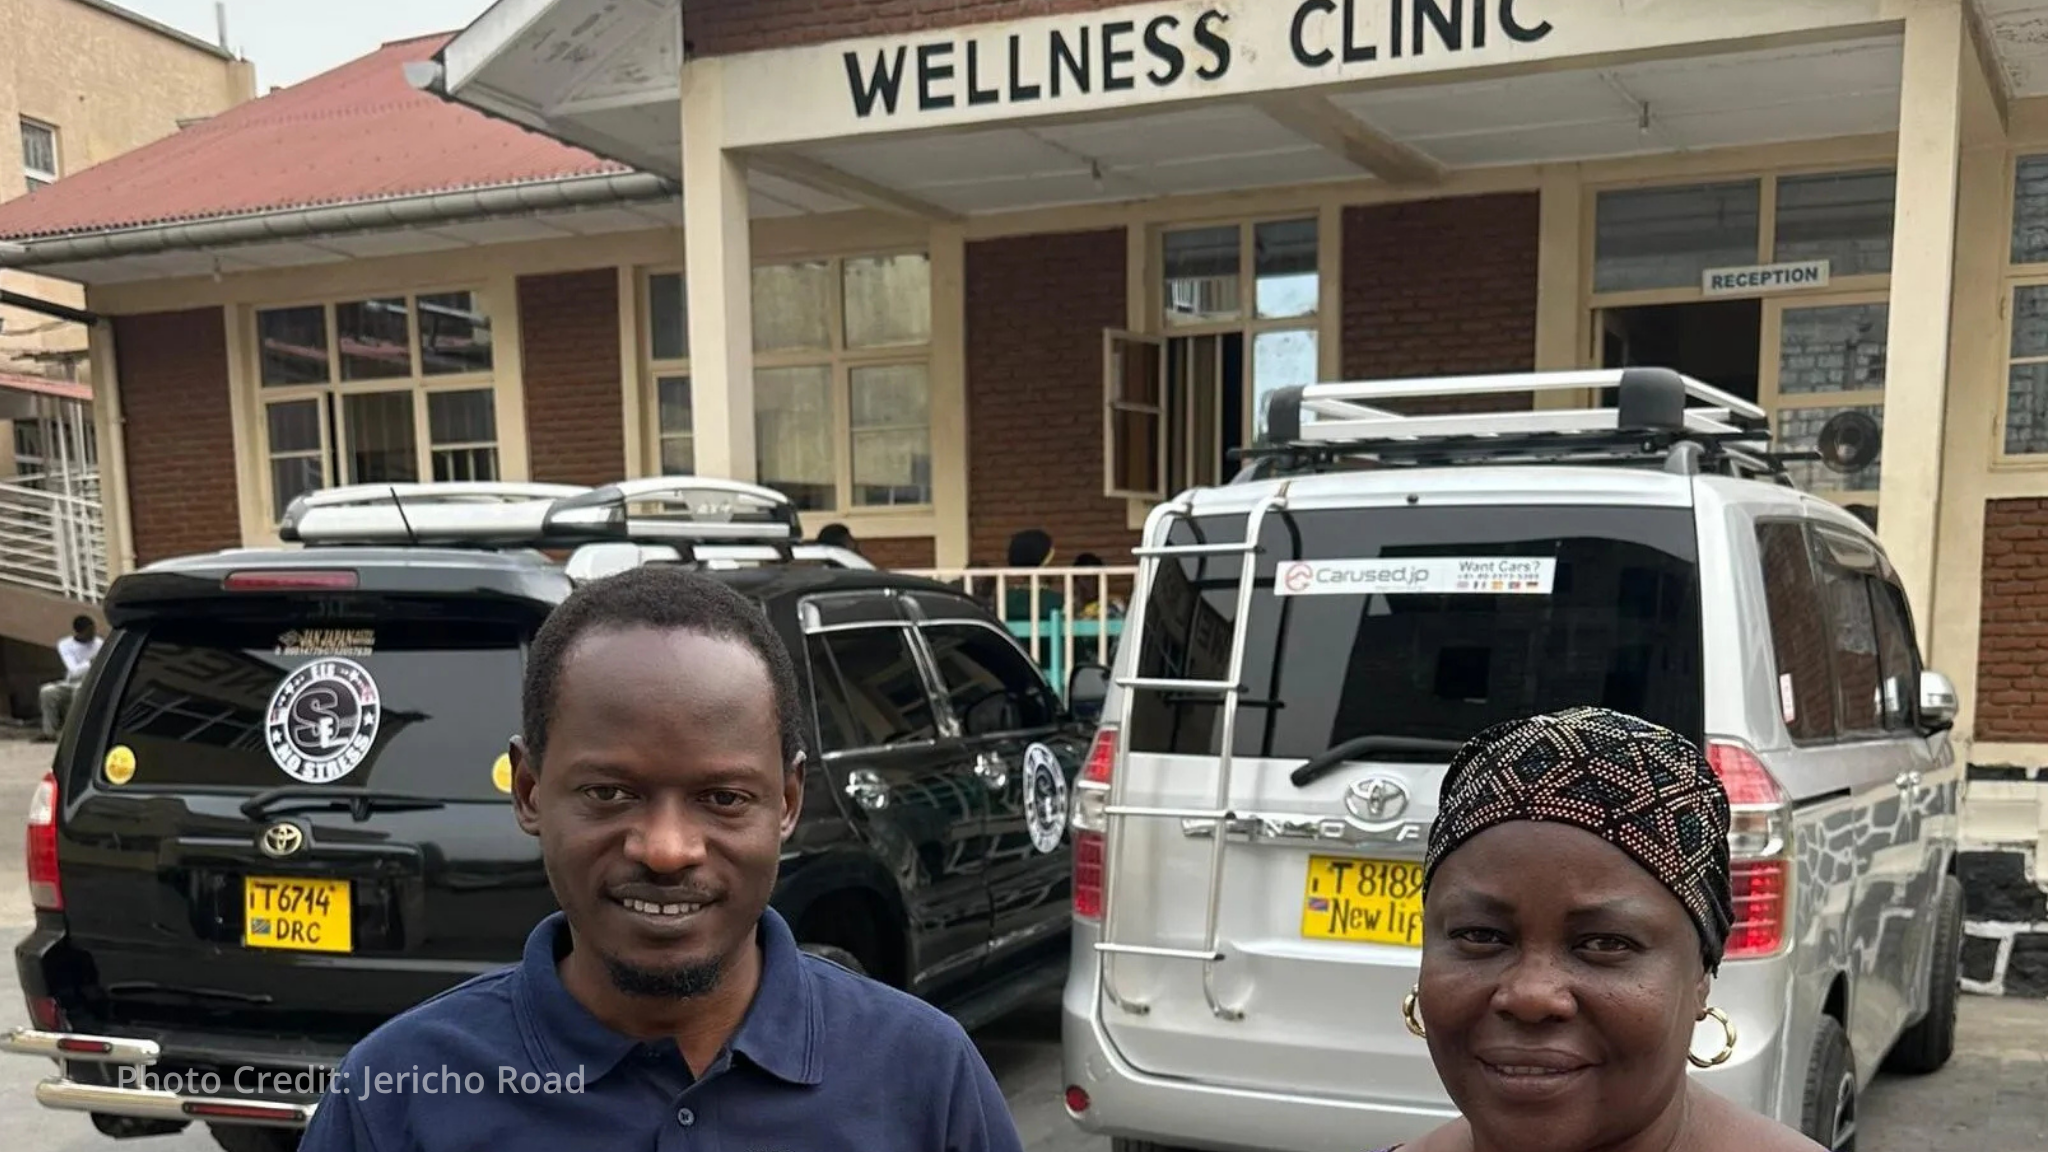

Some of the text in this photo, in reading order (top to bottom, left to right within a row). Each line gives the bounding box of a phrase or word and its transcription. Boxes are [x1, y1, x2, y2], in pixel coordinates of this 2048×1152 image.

[843, 0, 1553, 117] WELLNESS CLINIC
[1711, 266, 1818, 290] RECEPTION
[1316, 566, 1430, 585] Carused.jp
[1459, 560, 1494, 573] Want
[276, 735, 370, 779] NO STRESS
[276, 918, 322, 944] DRC
[1328, 898, 1424, 942] New lif
